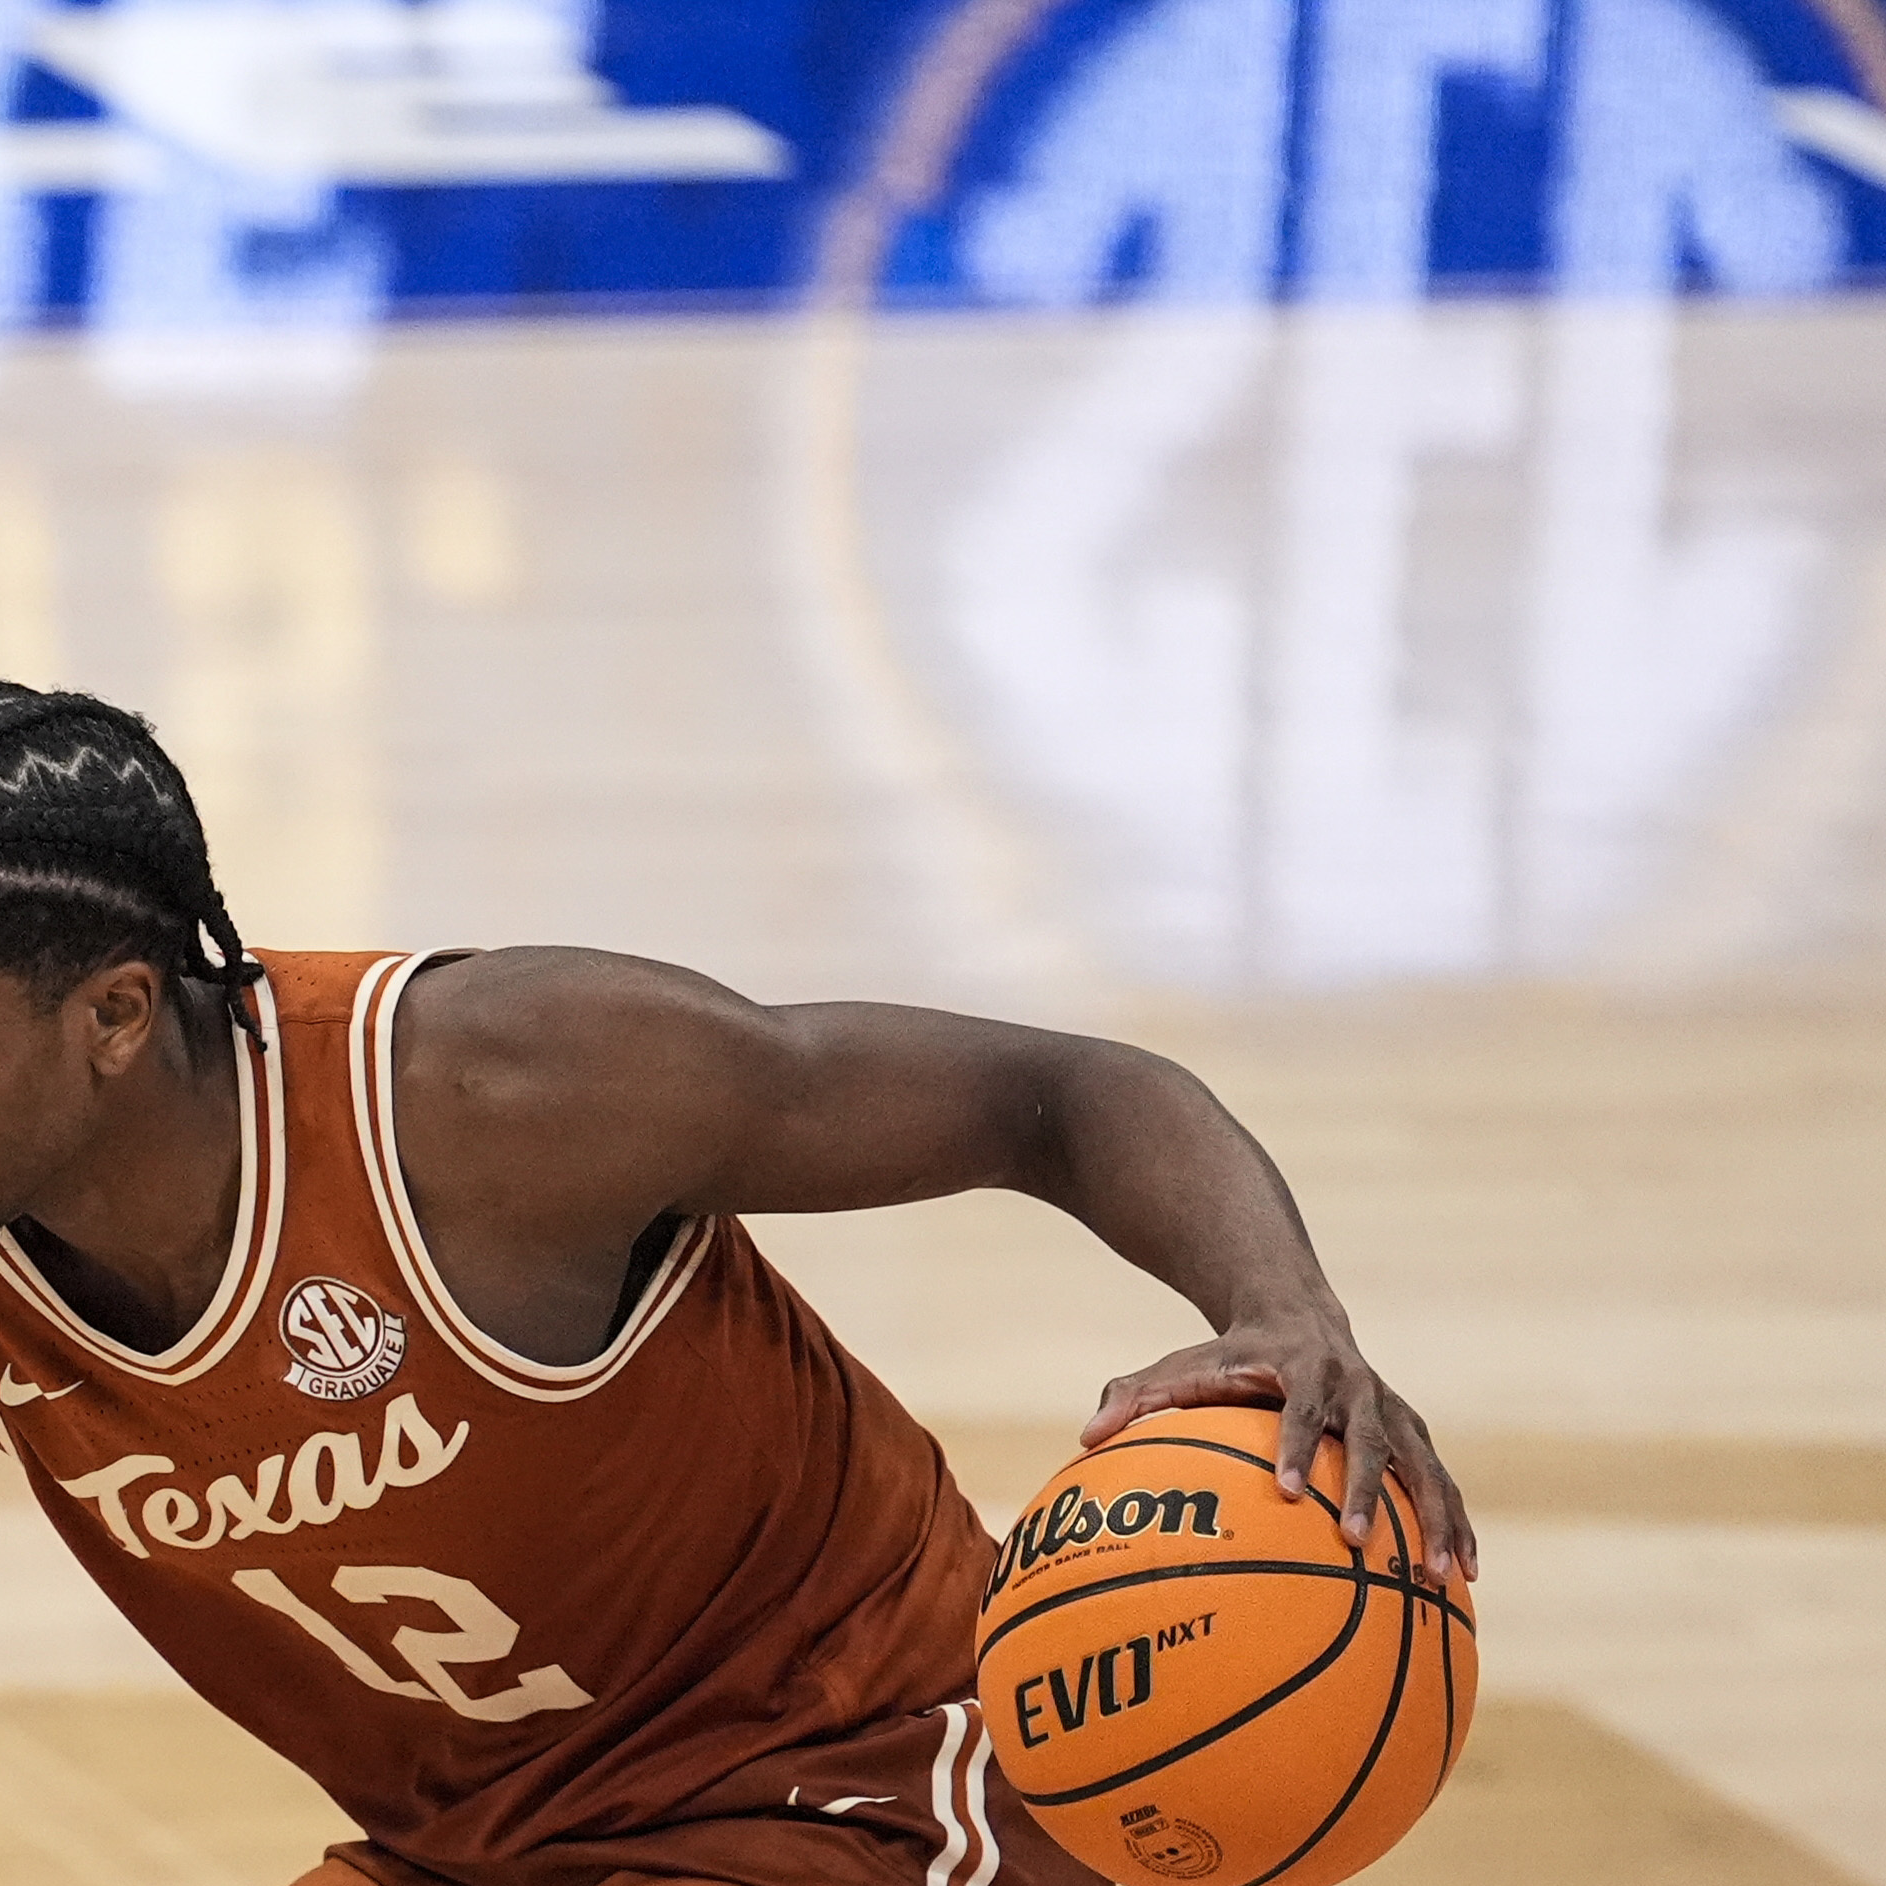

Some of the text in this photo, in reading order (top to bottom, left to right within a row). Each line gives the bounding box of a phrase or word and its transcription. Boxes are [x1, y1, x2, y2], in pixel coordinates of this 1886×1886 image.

[286, 1283, 377, 1370] SEC
[308, 1338, 403, 1400] GRADUATE
[55, 1392, 470, 1560] Texas
[1012, 1542, 1131, 1591] INDOOR GAME BALL
[231, 1565, 597, 1723] 12
[1157, 1612, 1217, 1652] NXT
